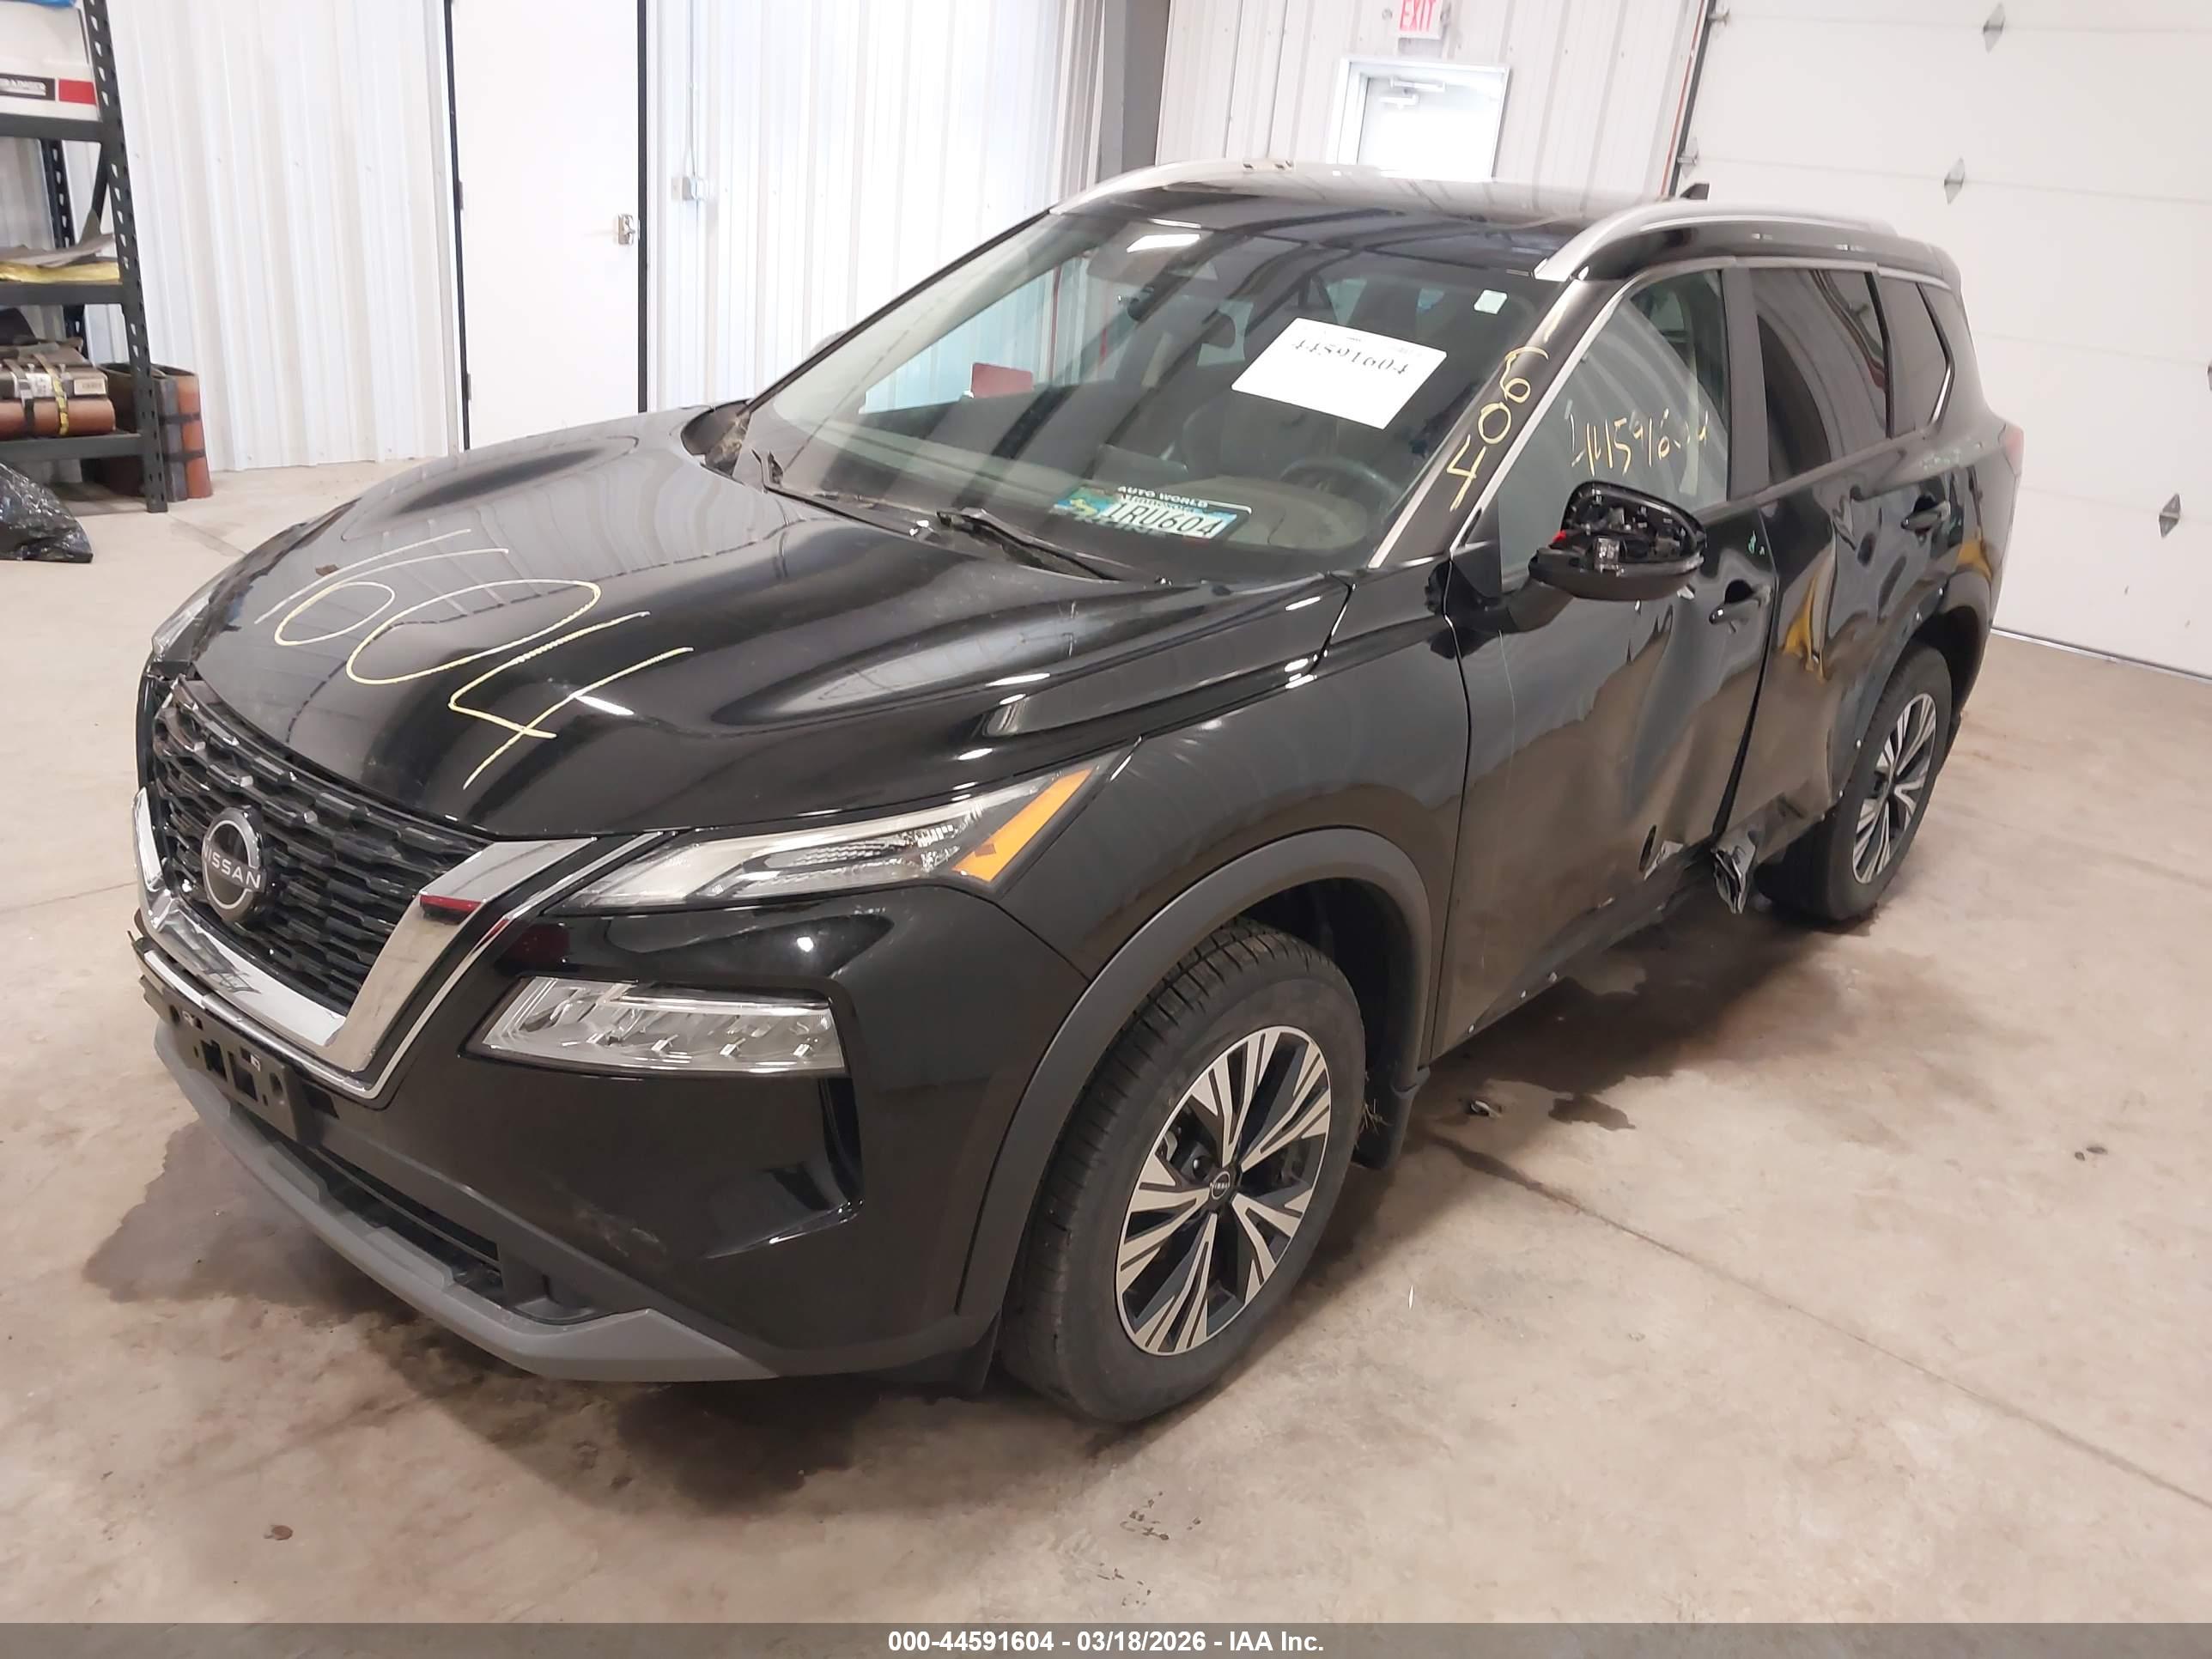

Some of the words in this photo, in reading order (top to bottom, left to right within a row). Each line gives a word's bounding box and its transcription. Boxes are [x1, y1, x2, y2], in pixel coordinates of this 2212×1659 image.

[1399, 0, 1437, 31] EXIT
[1291, 338, 1408, 374] 44591604
[1117, 485, 1156, 498] AUTO
[1159, 491, 1209, 508] WORLD
[254, 528, 694, 789] 1604
[202, 842, 261, 890] NISSAN
